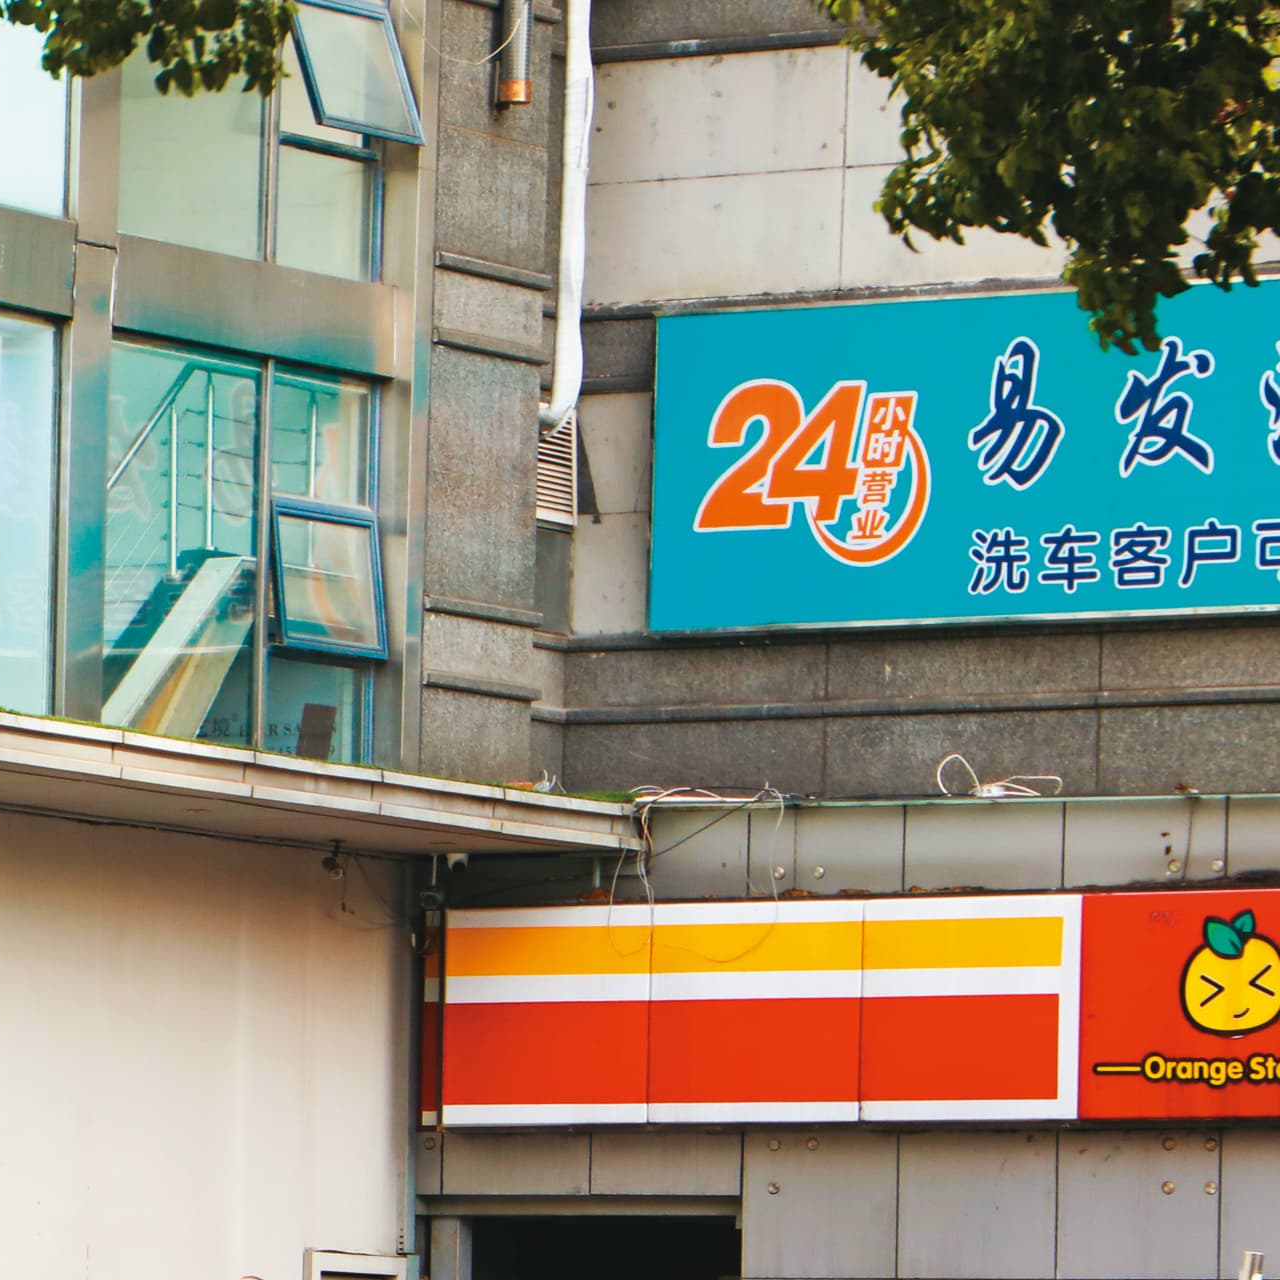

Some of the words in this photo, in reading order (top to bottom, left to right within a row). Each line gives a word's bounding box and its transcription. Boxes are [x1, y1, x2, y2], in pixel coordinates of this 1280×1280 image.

[693, 378, 867, 532] 24
[849, 391, 918, 543] 小时营业
[968, 335, 1280, 490] 易发
[1143, 1054, 1245, 1087] Orange
